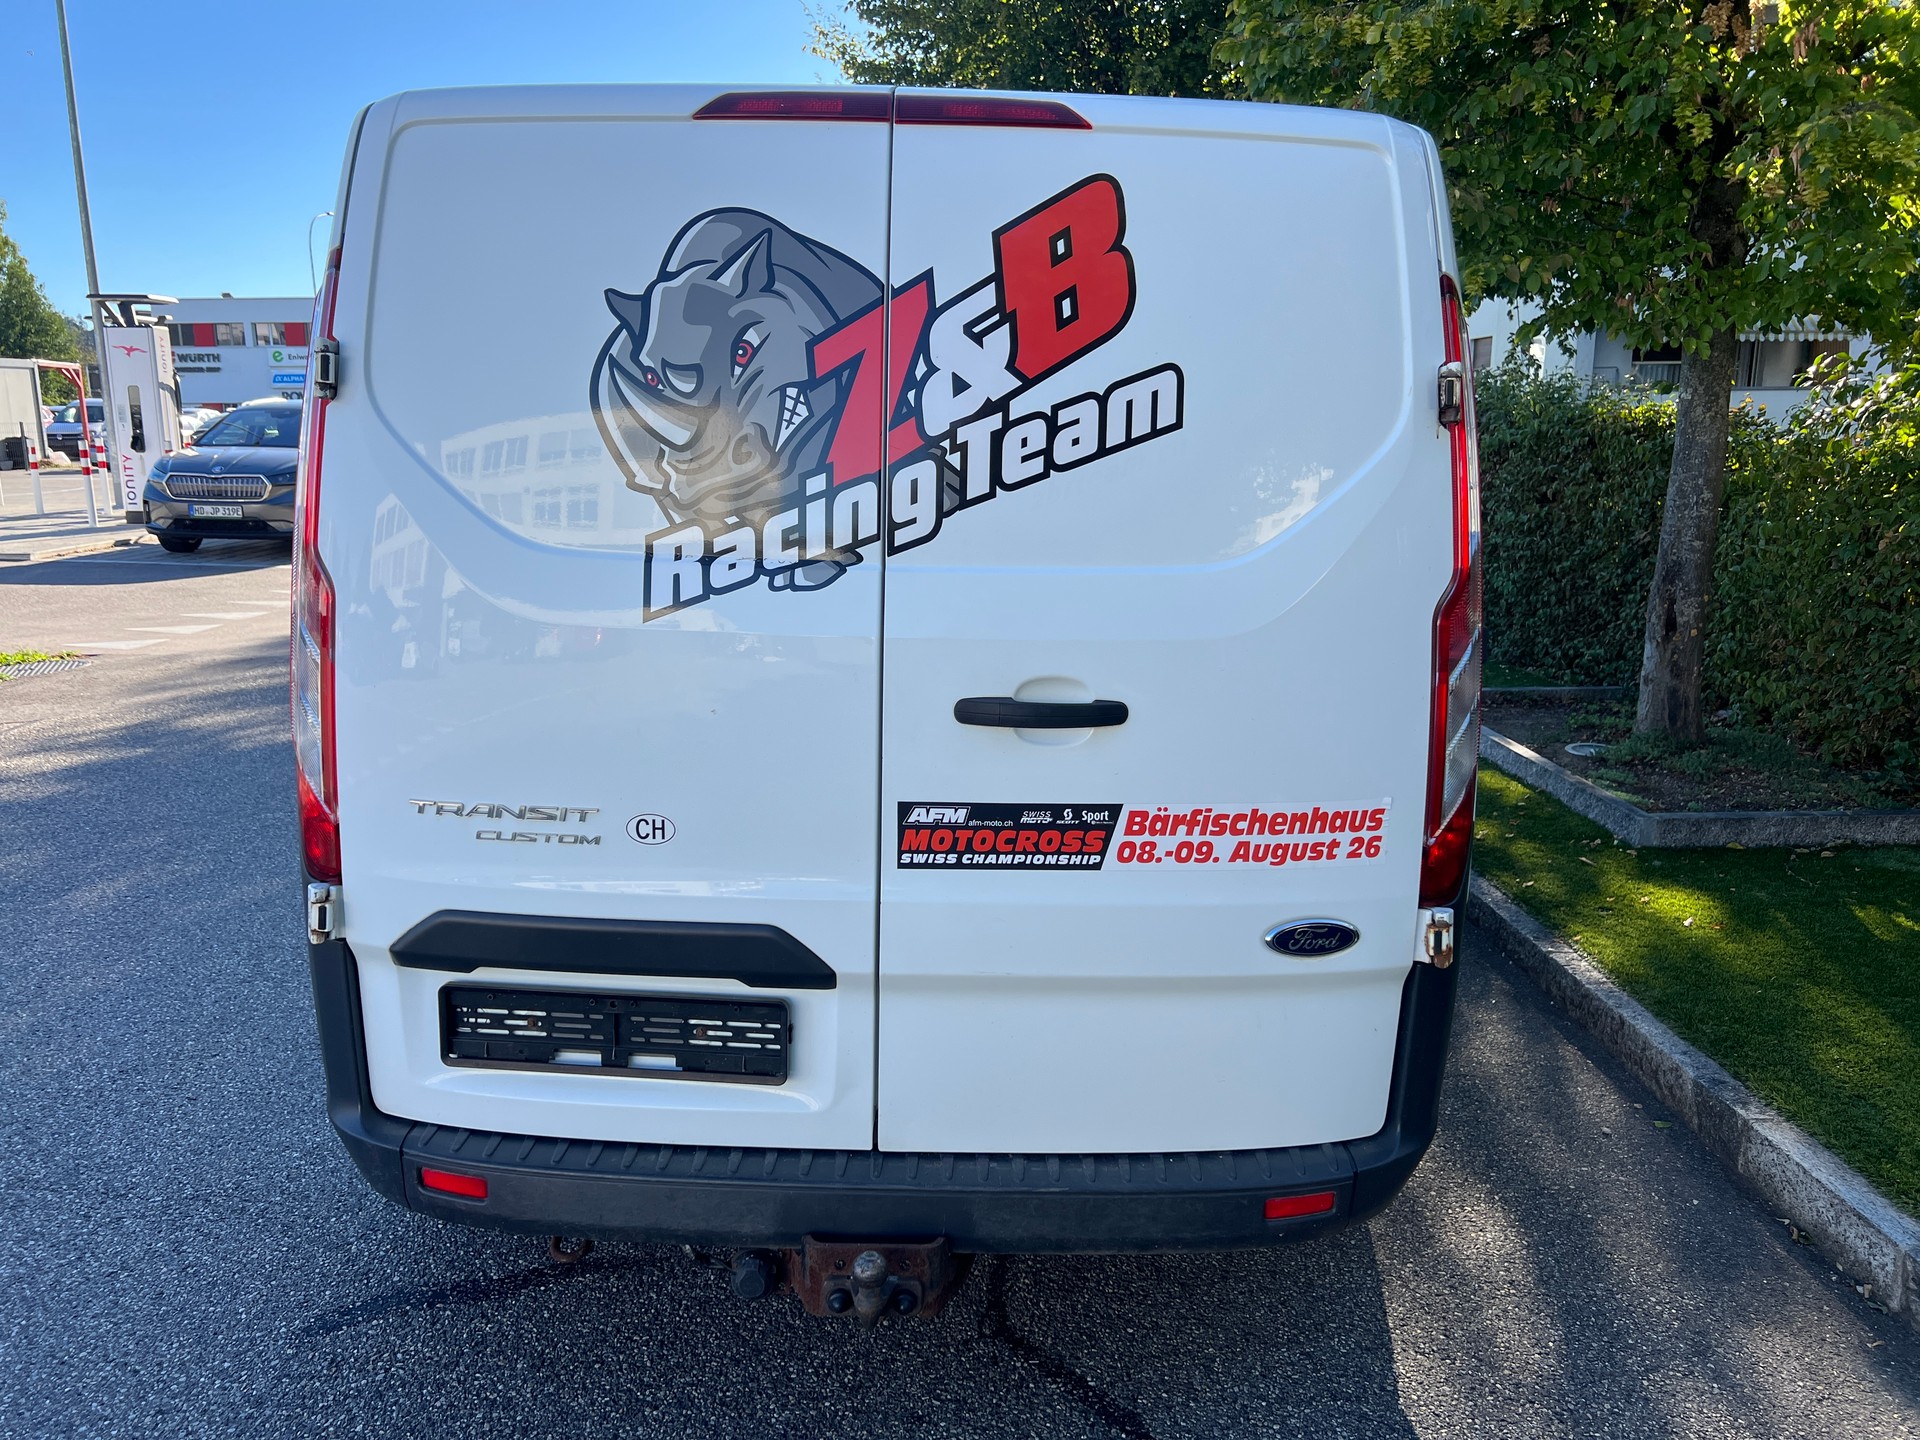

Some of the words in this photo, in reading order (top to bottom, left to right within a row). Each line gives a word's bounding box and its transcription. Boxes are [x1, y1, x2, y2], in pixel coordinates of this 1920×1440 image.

[176, 352, 221, 362] WÜRTH
[122, 454, 138, 505] IONITY
[645, 453, 943, 620] Racing
[952, 364, 1183, 507] Team
[194, 506, 205, 515] HD
[210, 506, 220, 516] JP
[221, 507, 241, 516] 319E
[408, 798, 600, 823] TRANSIT
[906, 806, 966, 824] AFM
[1022, 810, 1052, 818] SWISS
[1081, 810, 1109, 824] Sport
[635, 818, 666, 840] CH
[968, 819, 1014, 827] afm-moto.ch
[1123, 805, 1387, 837] Bärfischenhaus
[475, 830, 602, 846] CUSTOM
[901, 828, 1106, 853] MOTOCROSS
[900, 853, 958, 864] SWISS
[961, 853, 1102, 866] CHAMPIONSHIP
[1116, 839, 1220, 865] 08.-09.
[1228, 836, 1342, 867] August
[1346, 834, 1383, 860] 26
[1288, 927, 1342, 950] Ford
